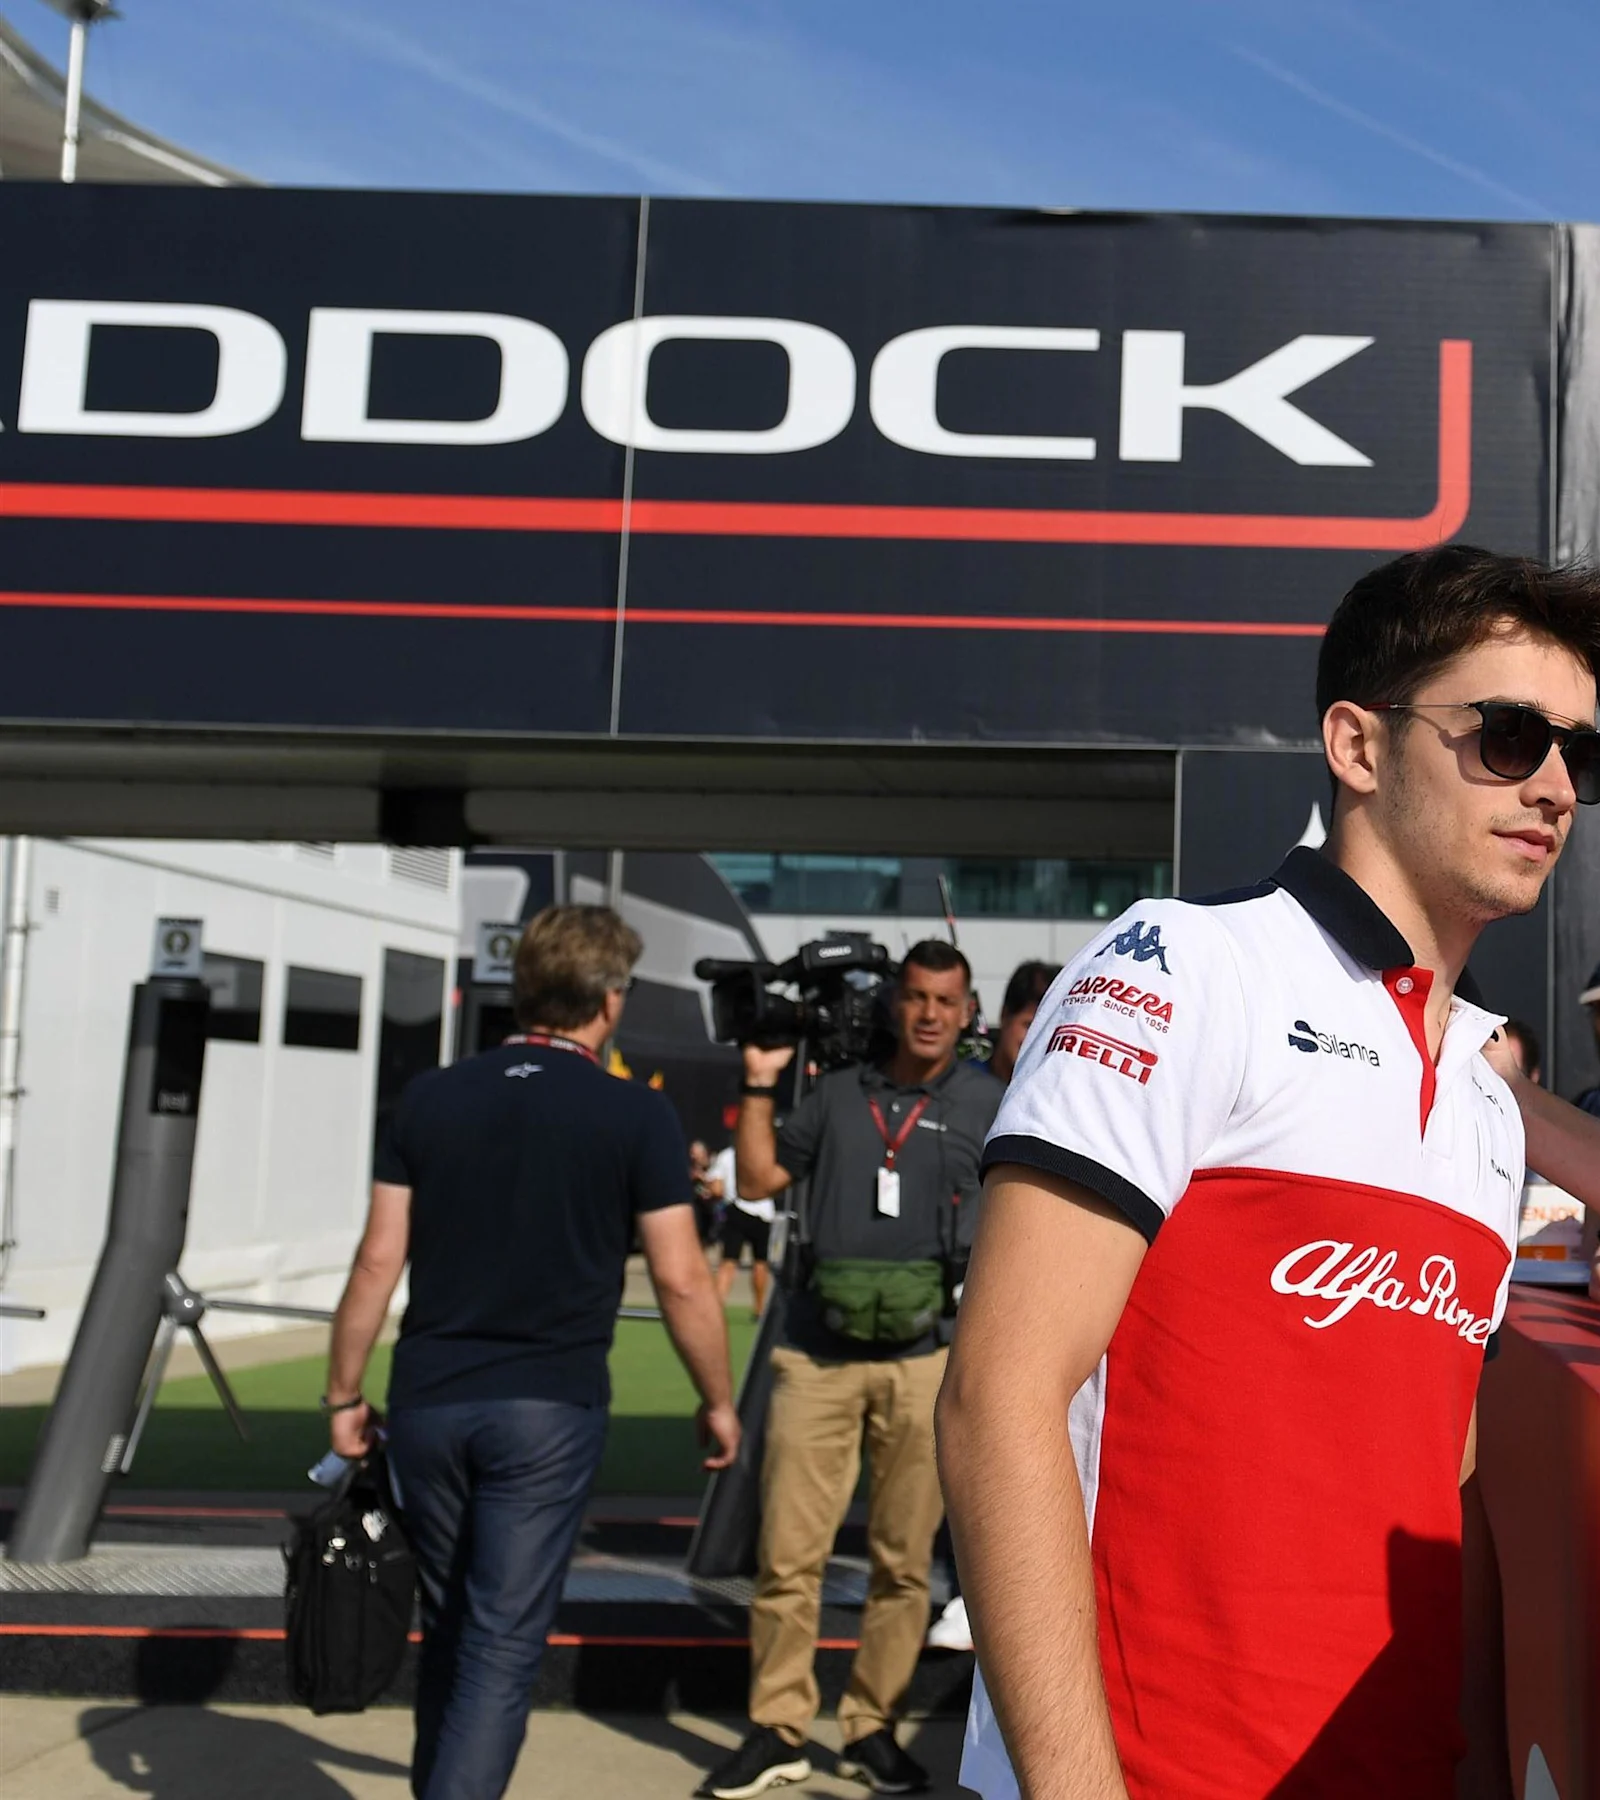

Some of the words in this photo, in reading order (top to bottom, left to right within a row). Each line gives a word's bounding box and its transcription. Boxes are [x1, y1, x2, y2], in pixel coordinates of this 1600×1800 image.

[0, 298, 1375, 468] DDOCK
[1067, 976, 1173, 1024] CARRERA
[1103, 1000, 1137, 1018] SINCE
[1144, 1016, 1170, 1034] 1956
[1045, 1024, 1158, 1086] PIRELLI
[1317, 1032, 1380, 1067] Silanna
[1270, 1239, 1411, 1329] Alfa
